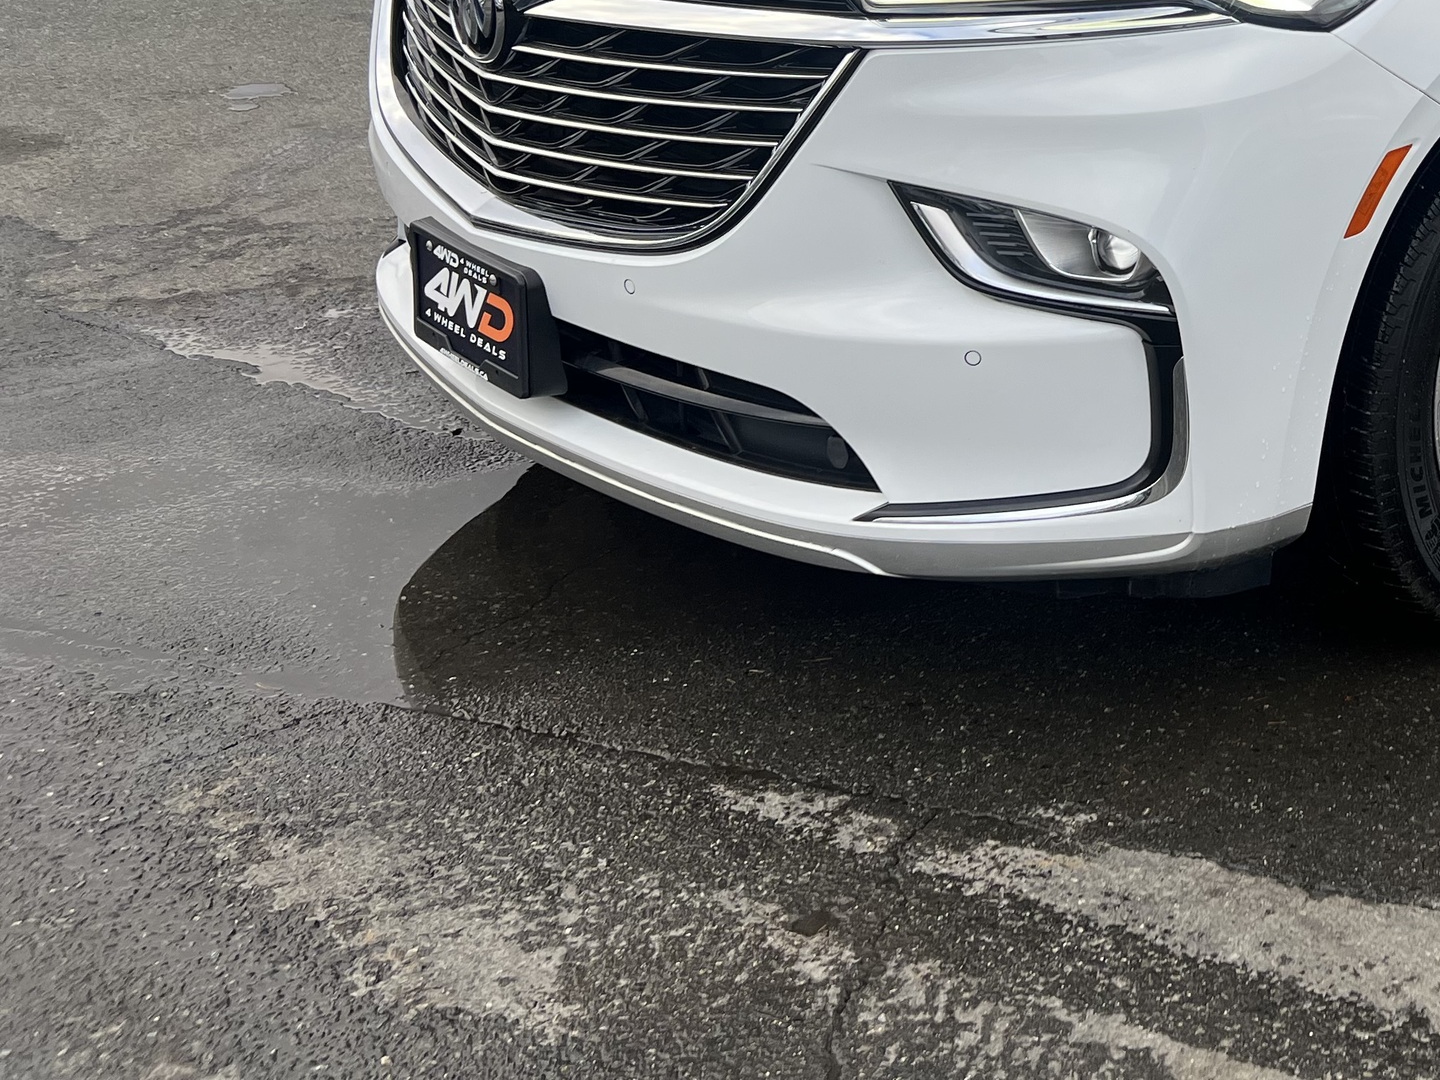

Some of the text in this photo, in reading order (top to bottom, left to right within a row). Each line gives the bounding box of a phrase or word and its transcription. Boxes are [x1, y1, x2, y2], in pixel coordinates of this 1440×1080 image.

[433, 245, 460, 268] 4WD
[463, 267, 488, 284] DEALS
[466, 260, 490, 278] WHEEL
[424, 267, 514, 343] 4WD
[425, 308, 507, 361] 4 WHEEL DEALS
